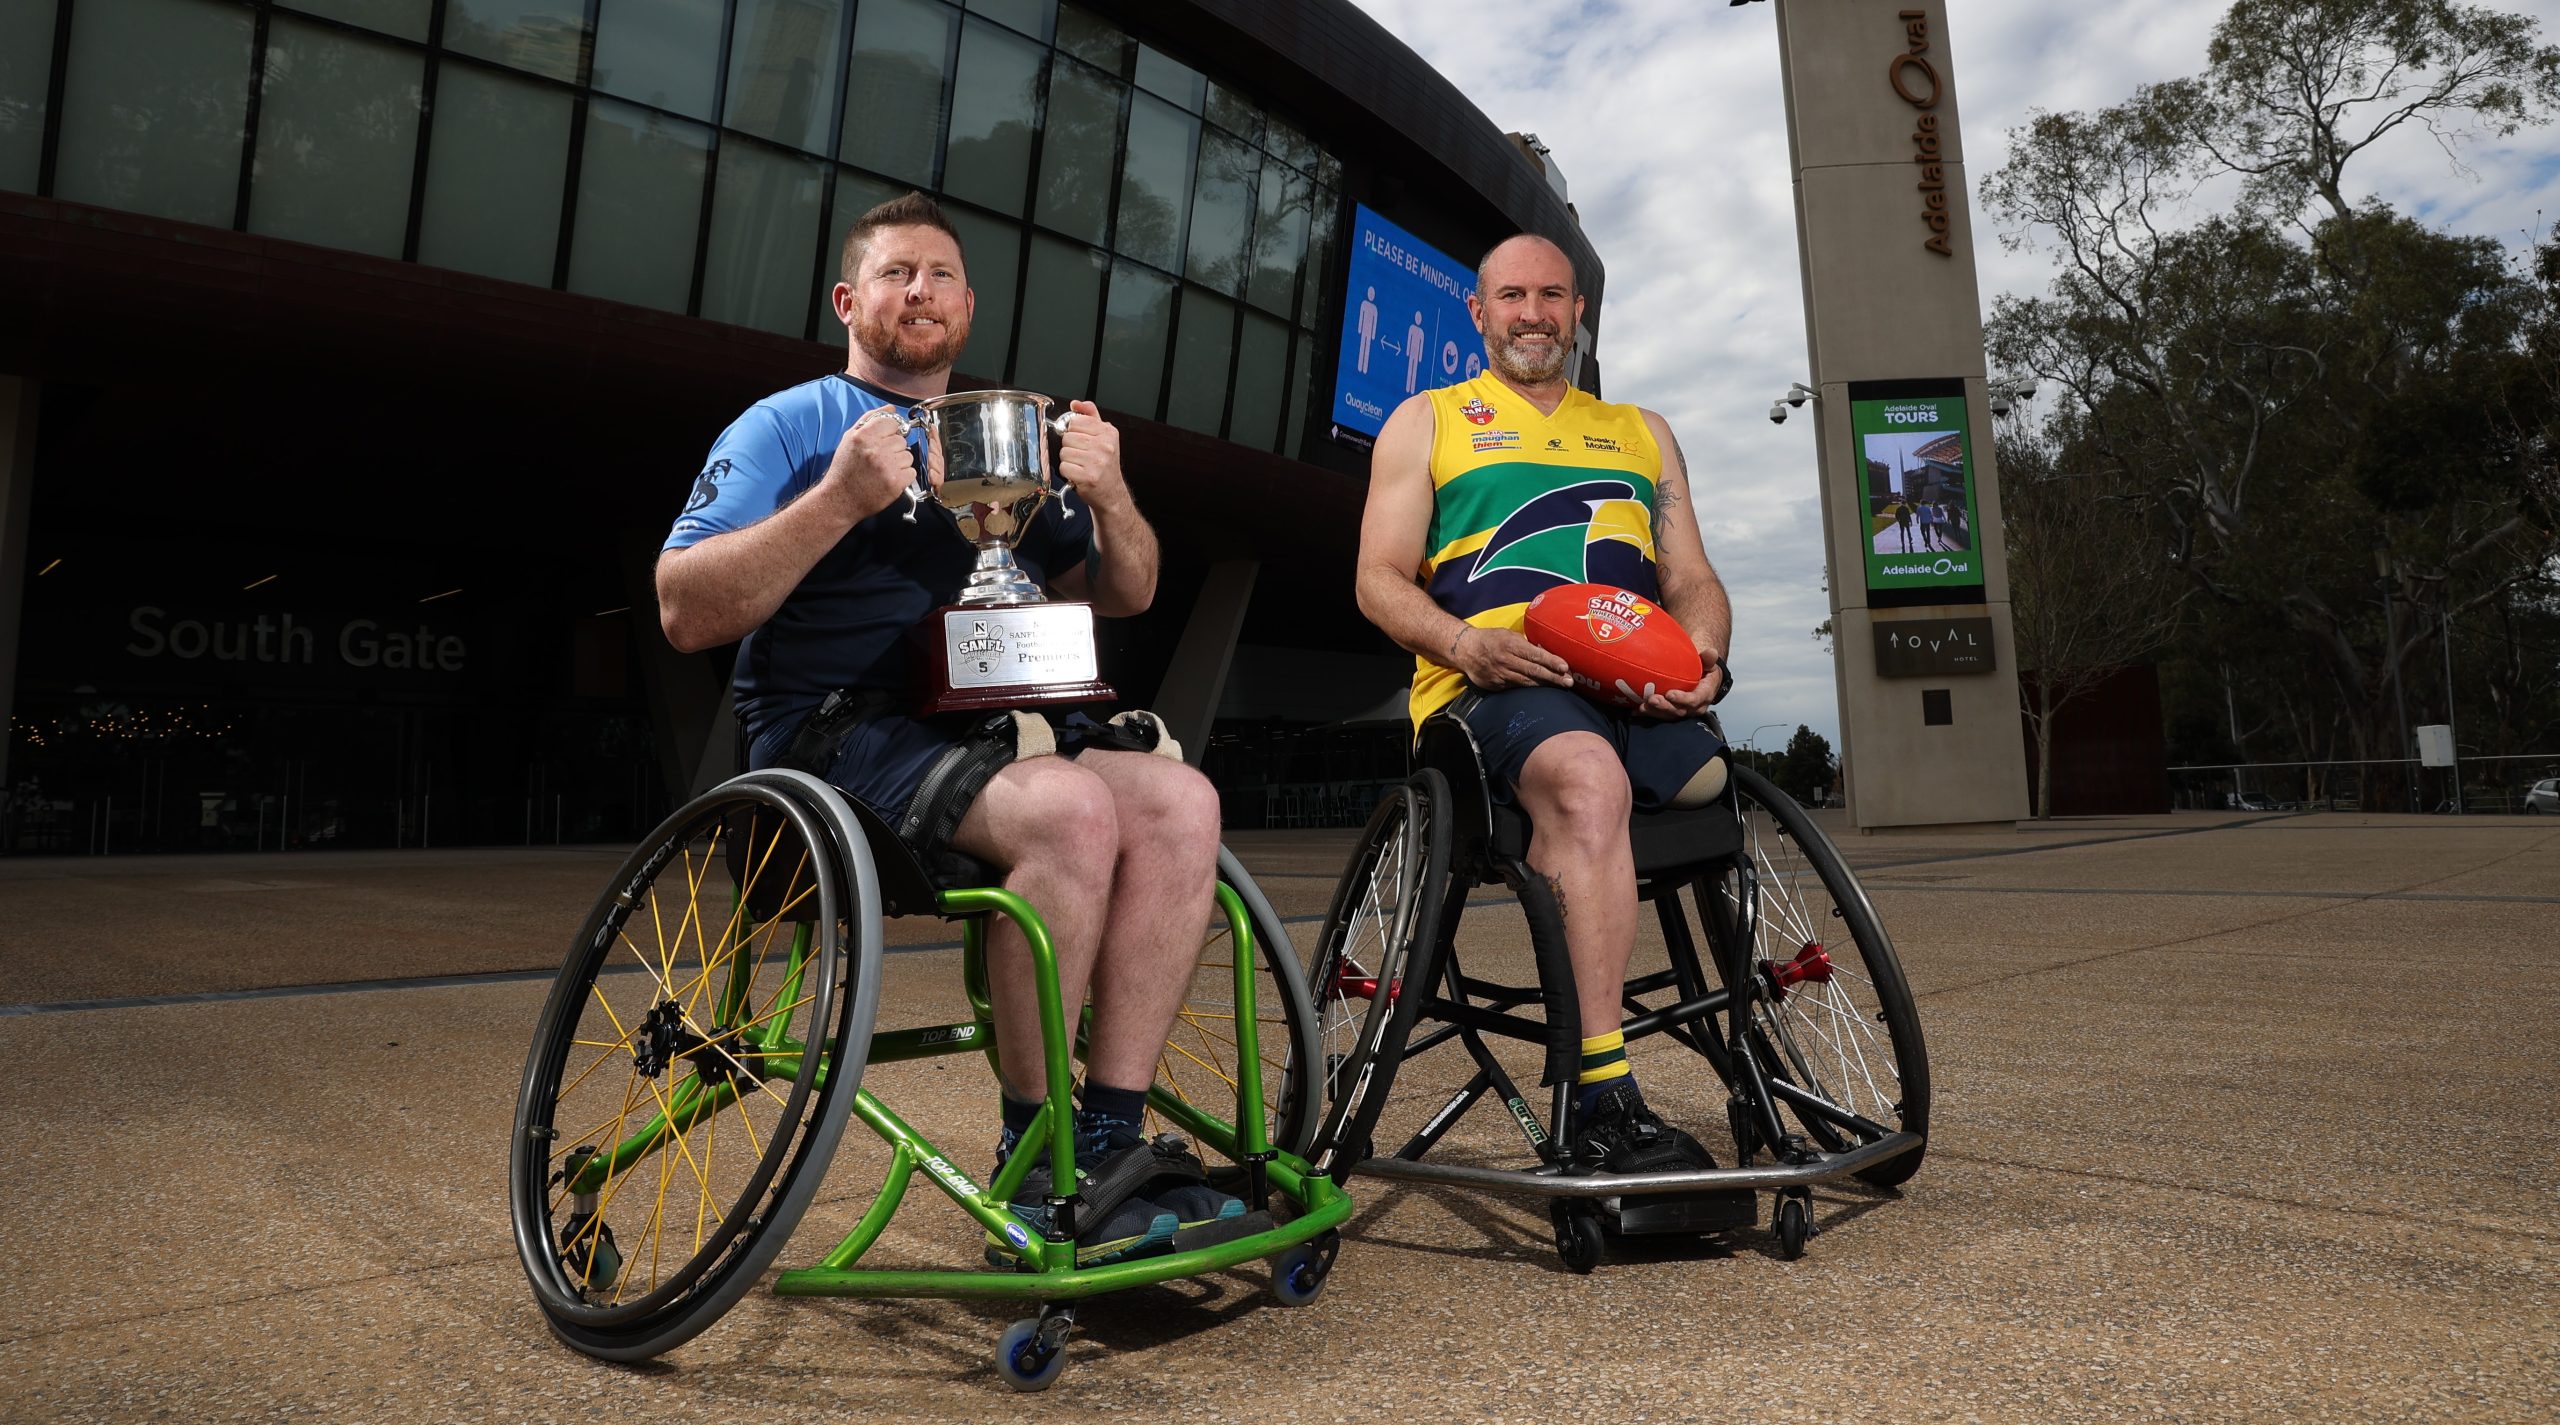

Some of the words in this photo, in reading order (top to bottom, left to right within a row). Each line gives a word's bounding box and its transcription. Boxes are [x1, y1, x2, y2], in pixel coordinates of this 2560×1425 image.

[1889, 10, 1942, 110] Oval
[1911, 112, 1952, 257] Adelaide
[1365, 229, 1404, 267] PLEASE
[1405, 252, 1419, 276] BE
[1420, 260, 1461, 299] MINDFUL
[1345, 392, 1383, 418] Quayclean
[1460, 406, 1497, 415] SANFL
[1884, 404, 1919, 413] Adelaide
[1919, 403, 1938, 411] Oval
[1884, 411, 1939, 425] TOURS
[1472, 435, 1520, 443] maughan
[1473, 441, 1503, 449] thiem
[1582, 434, 1617, 445] Bluesky
[1585, 442, 1622, 453] Mobility
[1882, 563, 1931, 576] Adelaide
[1932, 558, 1968, 576] Oval
[1590, 598, 1644, 629] SANFL
[1592, 609, 1632, 629] WHEELCHAIR
[124, 604, 316, 665] South
[338, 616, 467, 672] Gate
[958, 639, 1005, 655] SANFL
[921, 1029, 948, 1043] TOP
[949, 1025, 976, 1039] END
[925, 1155, 955, 1177] TOP
[950, 1172, 980, 1196] END
